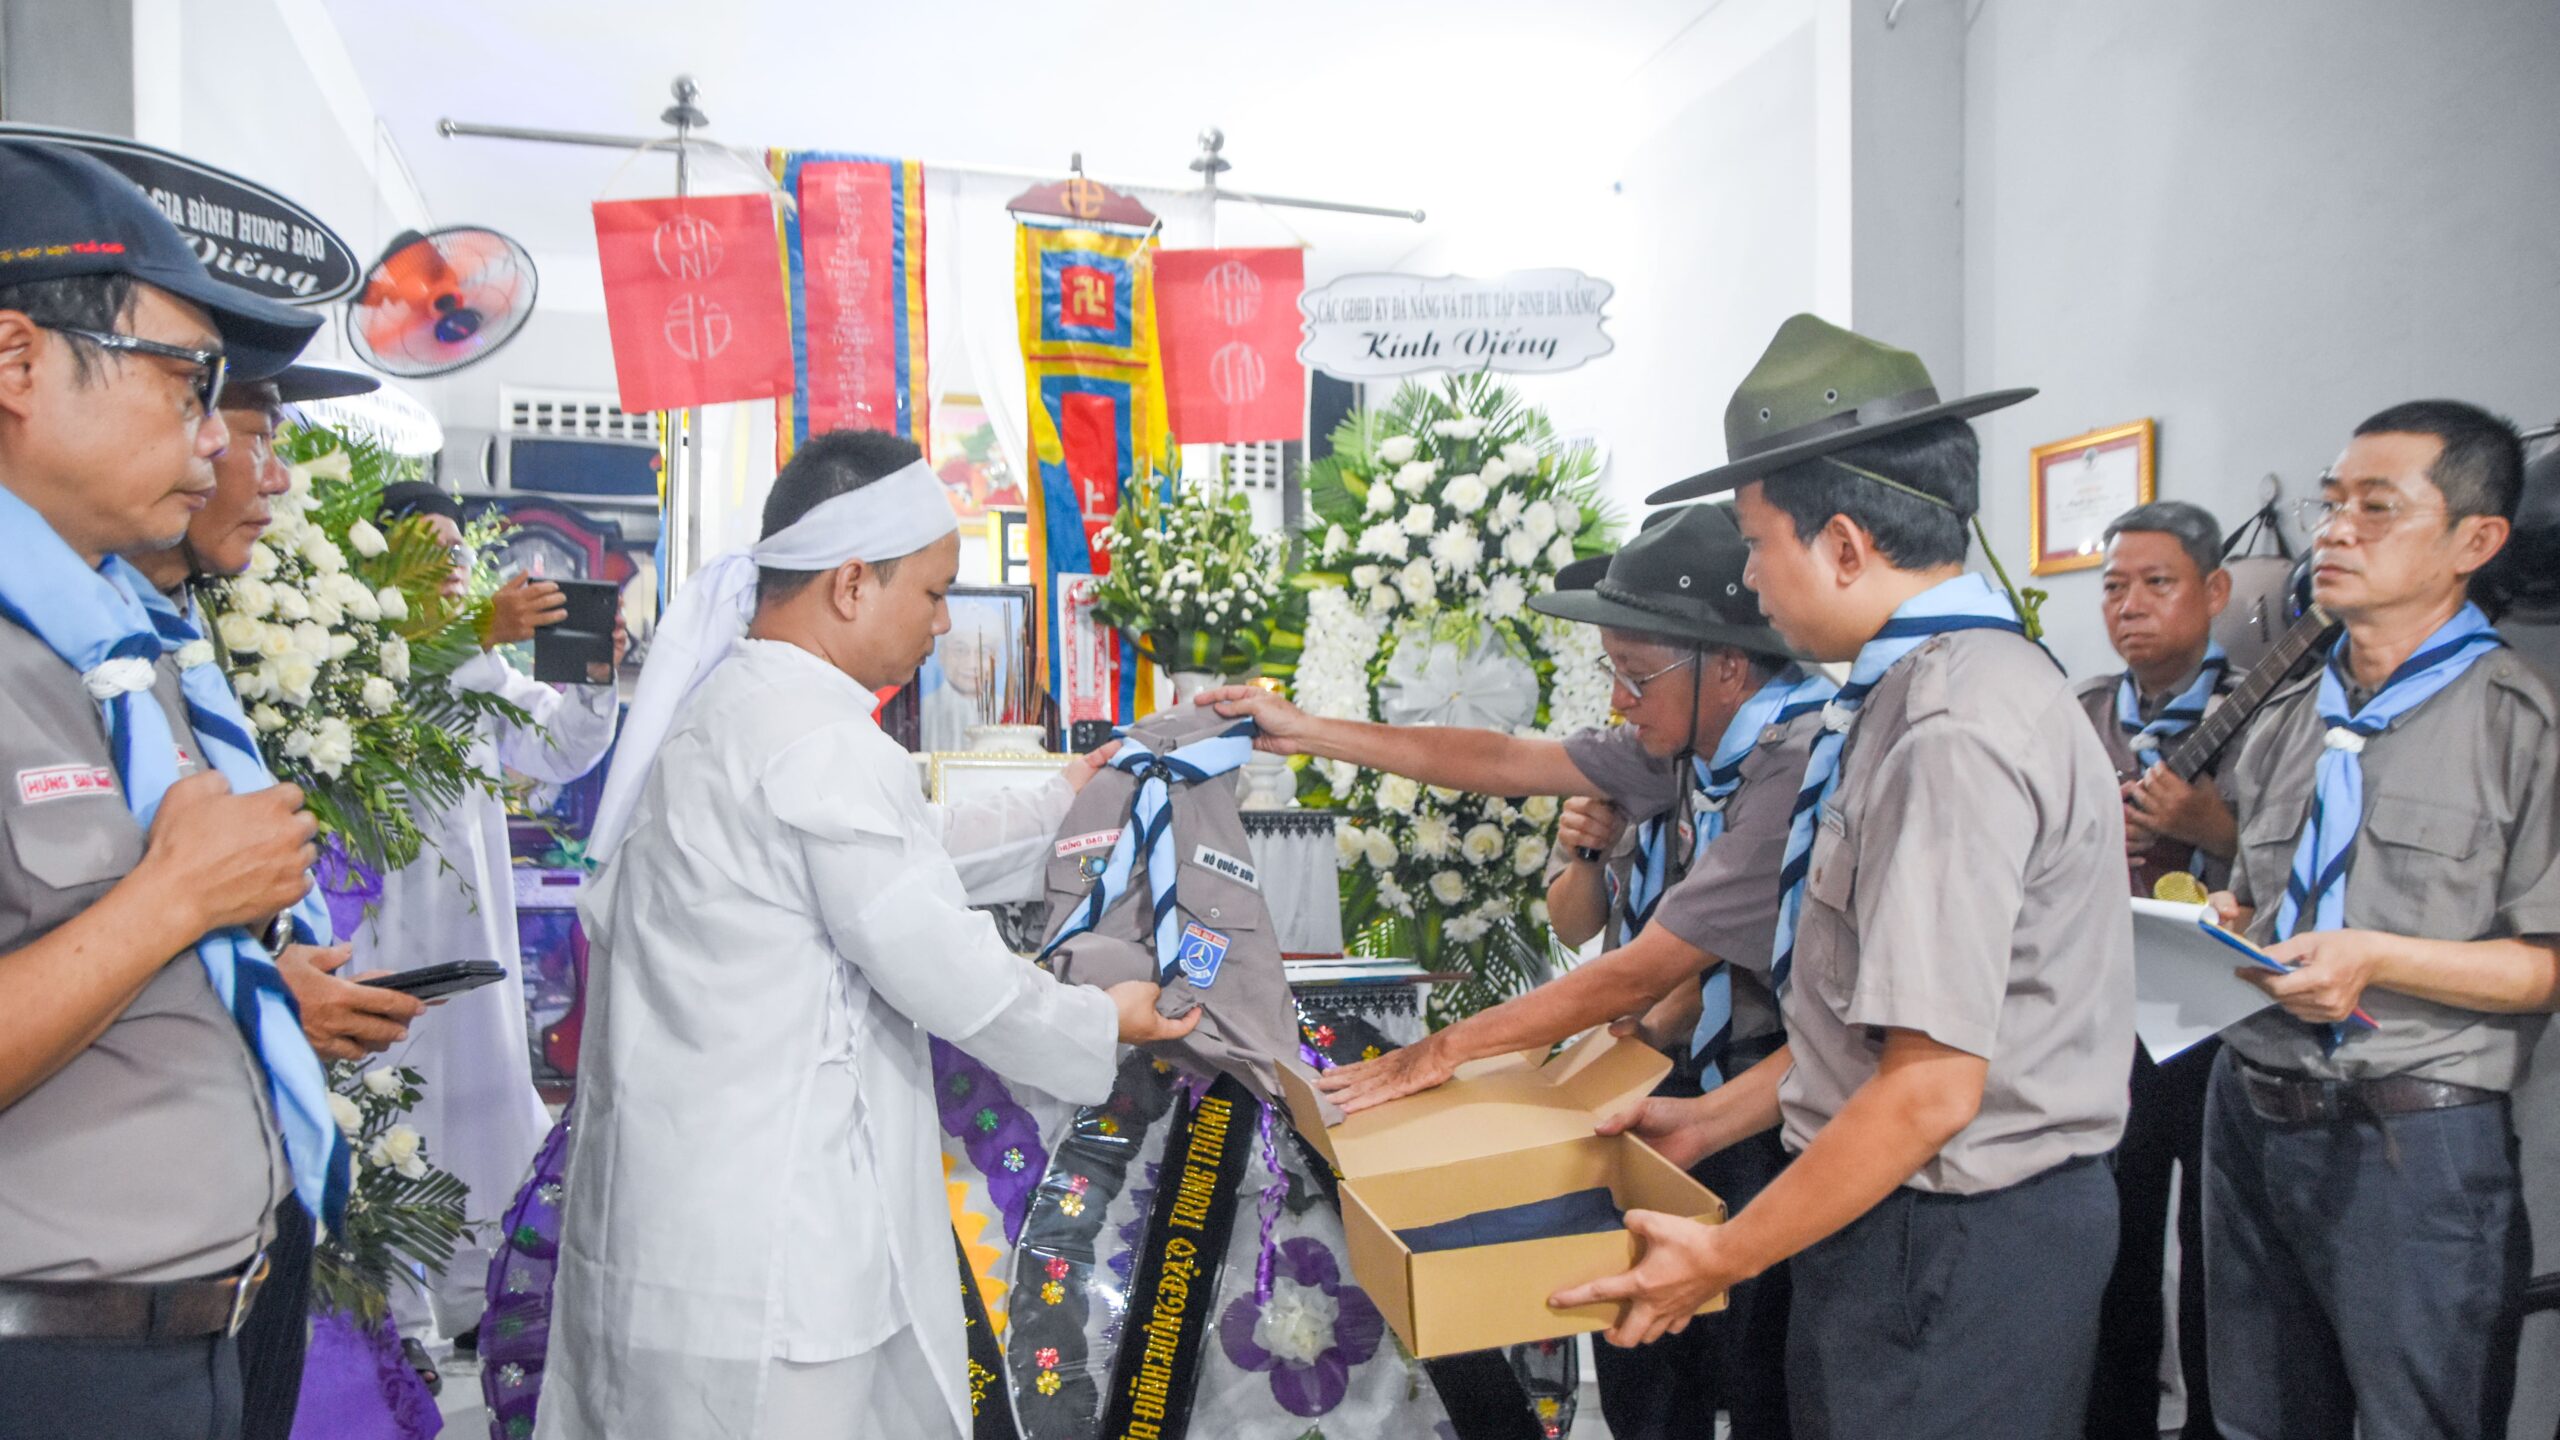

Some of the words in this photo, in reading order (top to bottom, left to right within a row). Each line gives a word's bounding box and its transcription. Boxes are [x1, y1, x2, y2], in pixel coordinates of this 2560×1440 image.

[188, 195, 235, 240] ĐÌNH
[291, 224, 326, 264] ĐẠO
[1359, 330, 1441, 360] Kính
[1168, 1164, 1218, 1230] TRUNG
